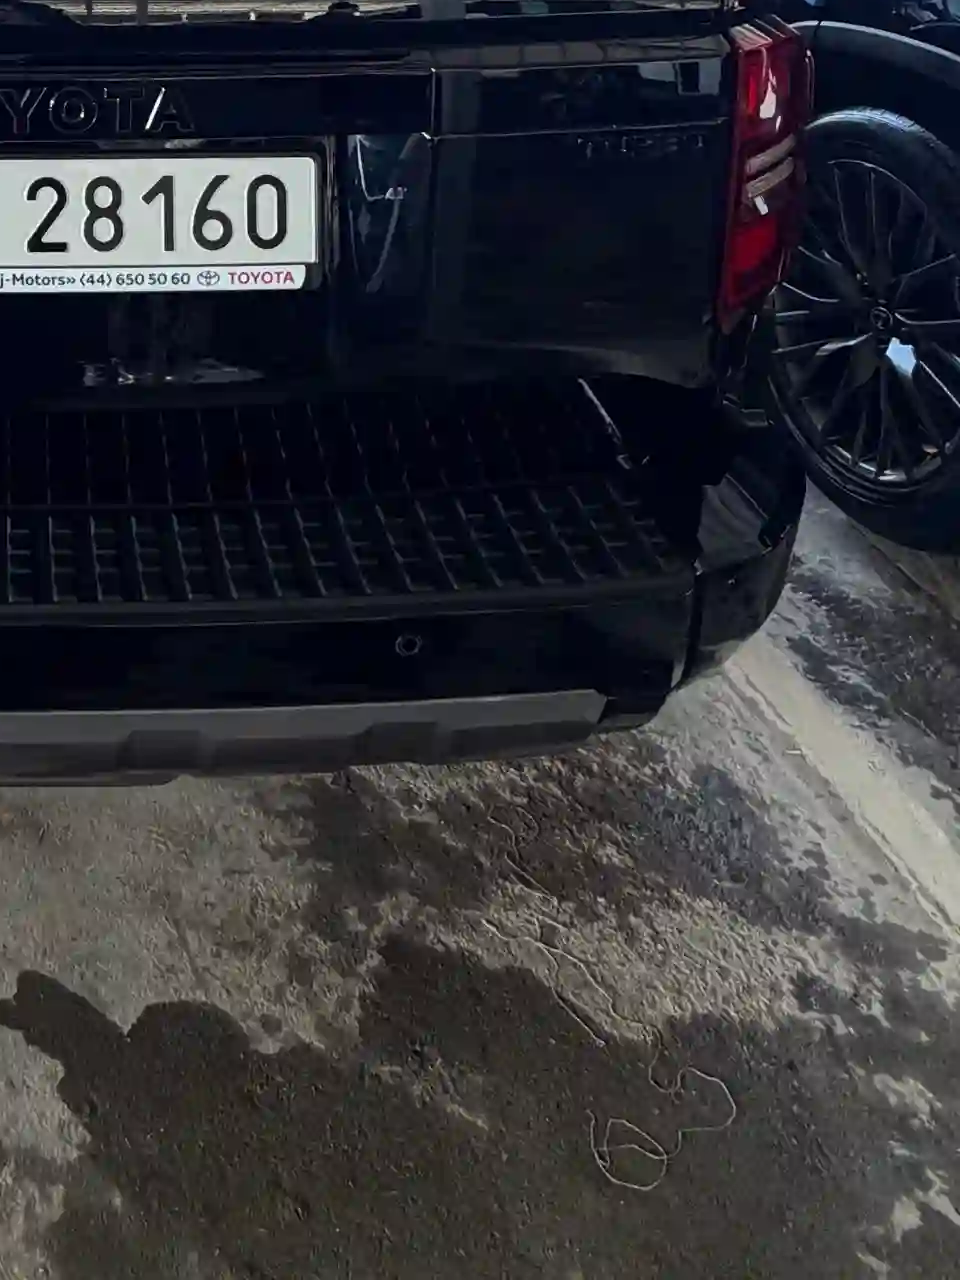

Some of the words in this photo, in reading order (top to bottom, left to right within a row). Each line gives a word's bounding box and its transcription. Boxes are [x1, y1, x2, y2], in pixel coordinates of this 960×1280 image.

[25, 174, 288, 254] 28160
[79, 272, 113, 287] (44)
[115, 272, 145, 286] 650
[147, 272, 168, 286] 50
[171, 272, 191, 286] 60
[228, 271, 296, 286] TOYOTA
